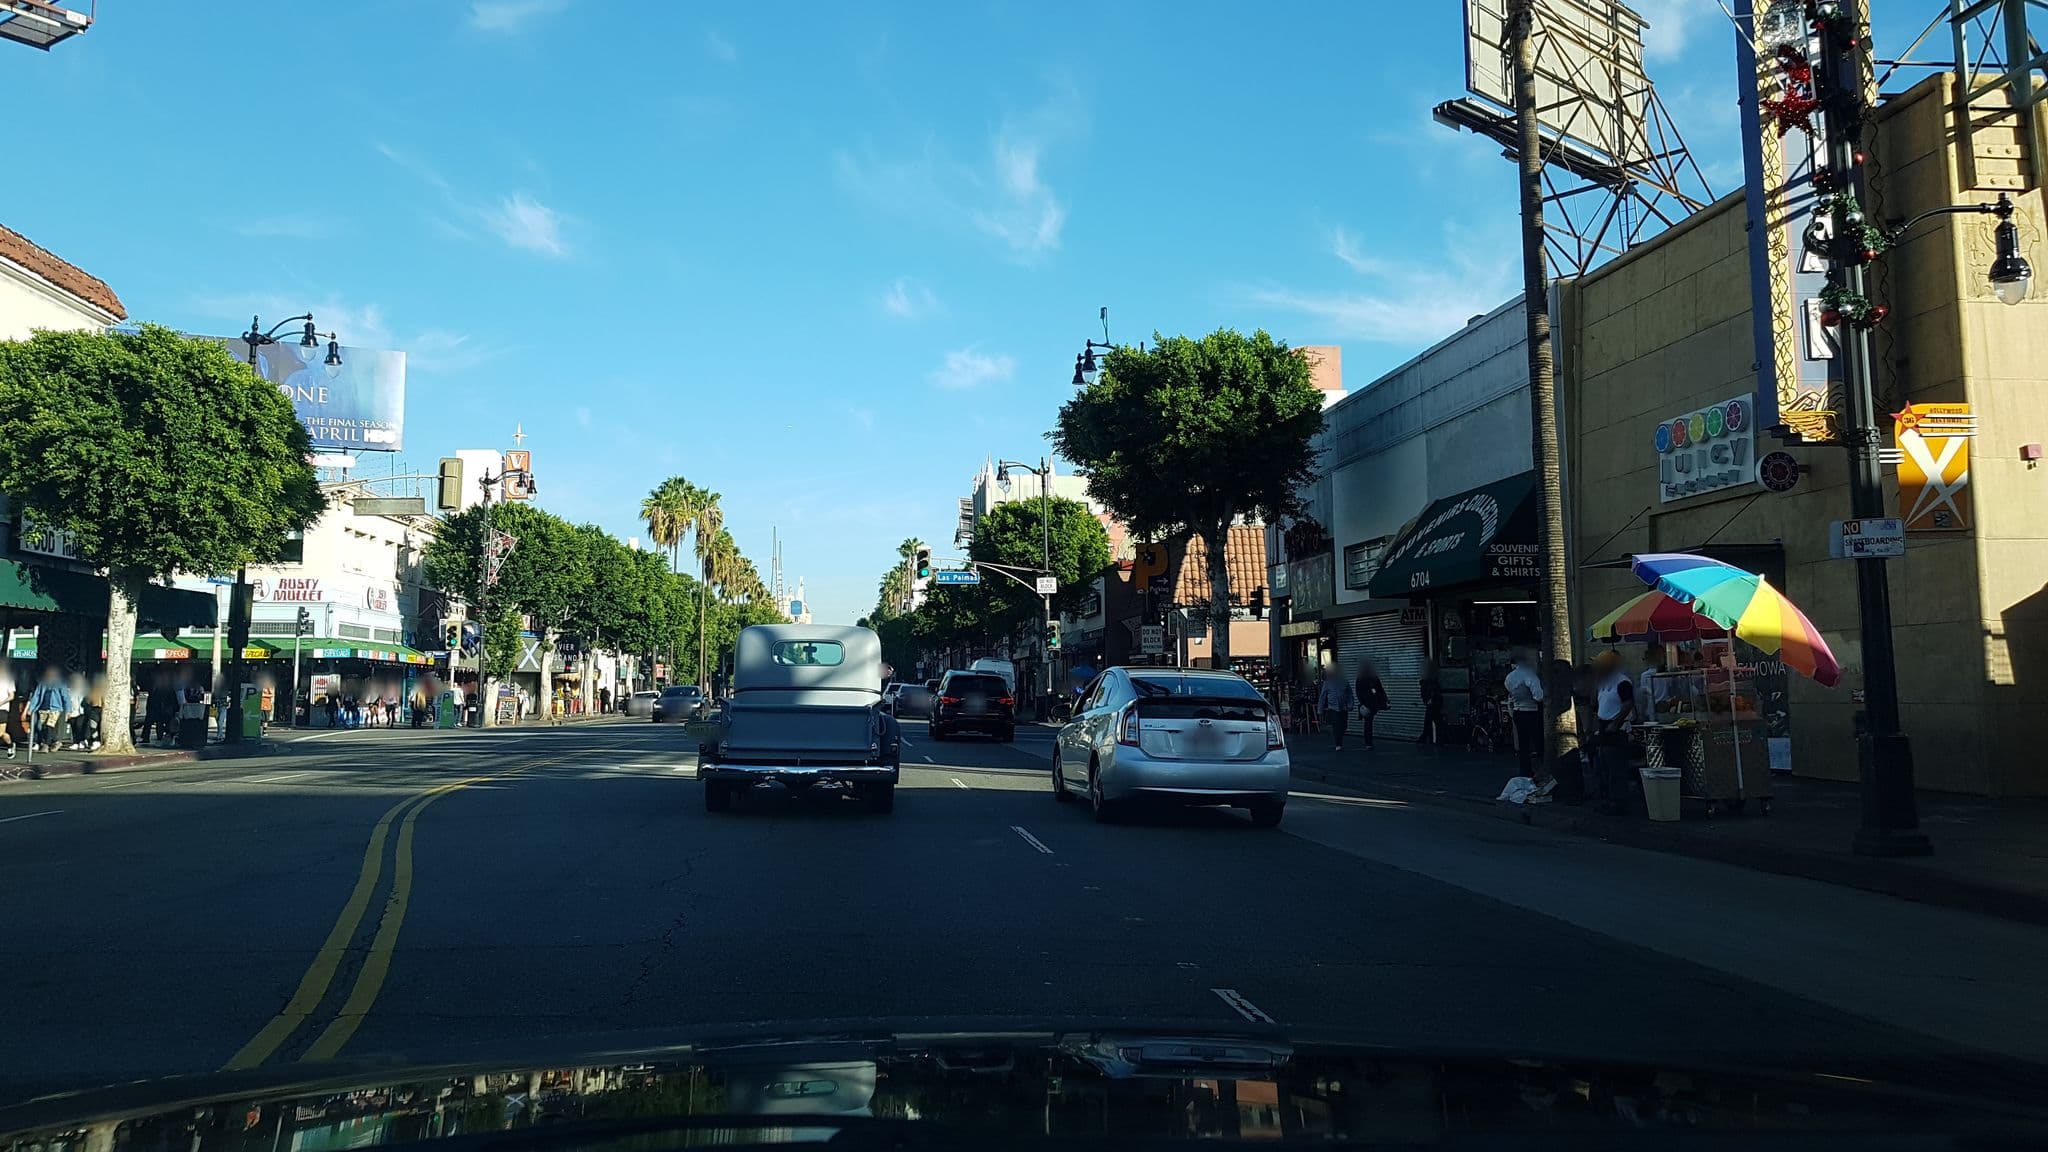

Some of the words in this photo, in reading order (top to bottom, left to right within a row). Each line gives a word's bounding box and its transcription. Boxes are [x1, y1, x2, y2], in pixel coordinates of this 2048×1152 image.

[305, 416, 326, 426] THE
[328, 418, 357, 428] FINAL
[307, 427, 360, 442] APRIL
[1384, 498, 1469, 569] SOUVENIRS
[1843, 521, 1860, 535] NO
[1497, 555, 1534, 566] GIFTS
[937, 573, 950, 581] Las
[1491, 567, 1500, 577] &
[1503, 567, 1541, 577] SHIRTS
[279, 578, 320, 590] RUSTY
[1410, 570, 1431, 588] 6704
[273, 590, 324, 601] MULLET
[1400, 608, 1426, 621] ATM
